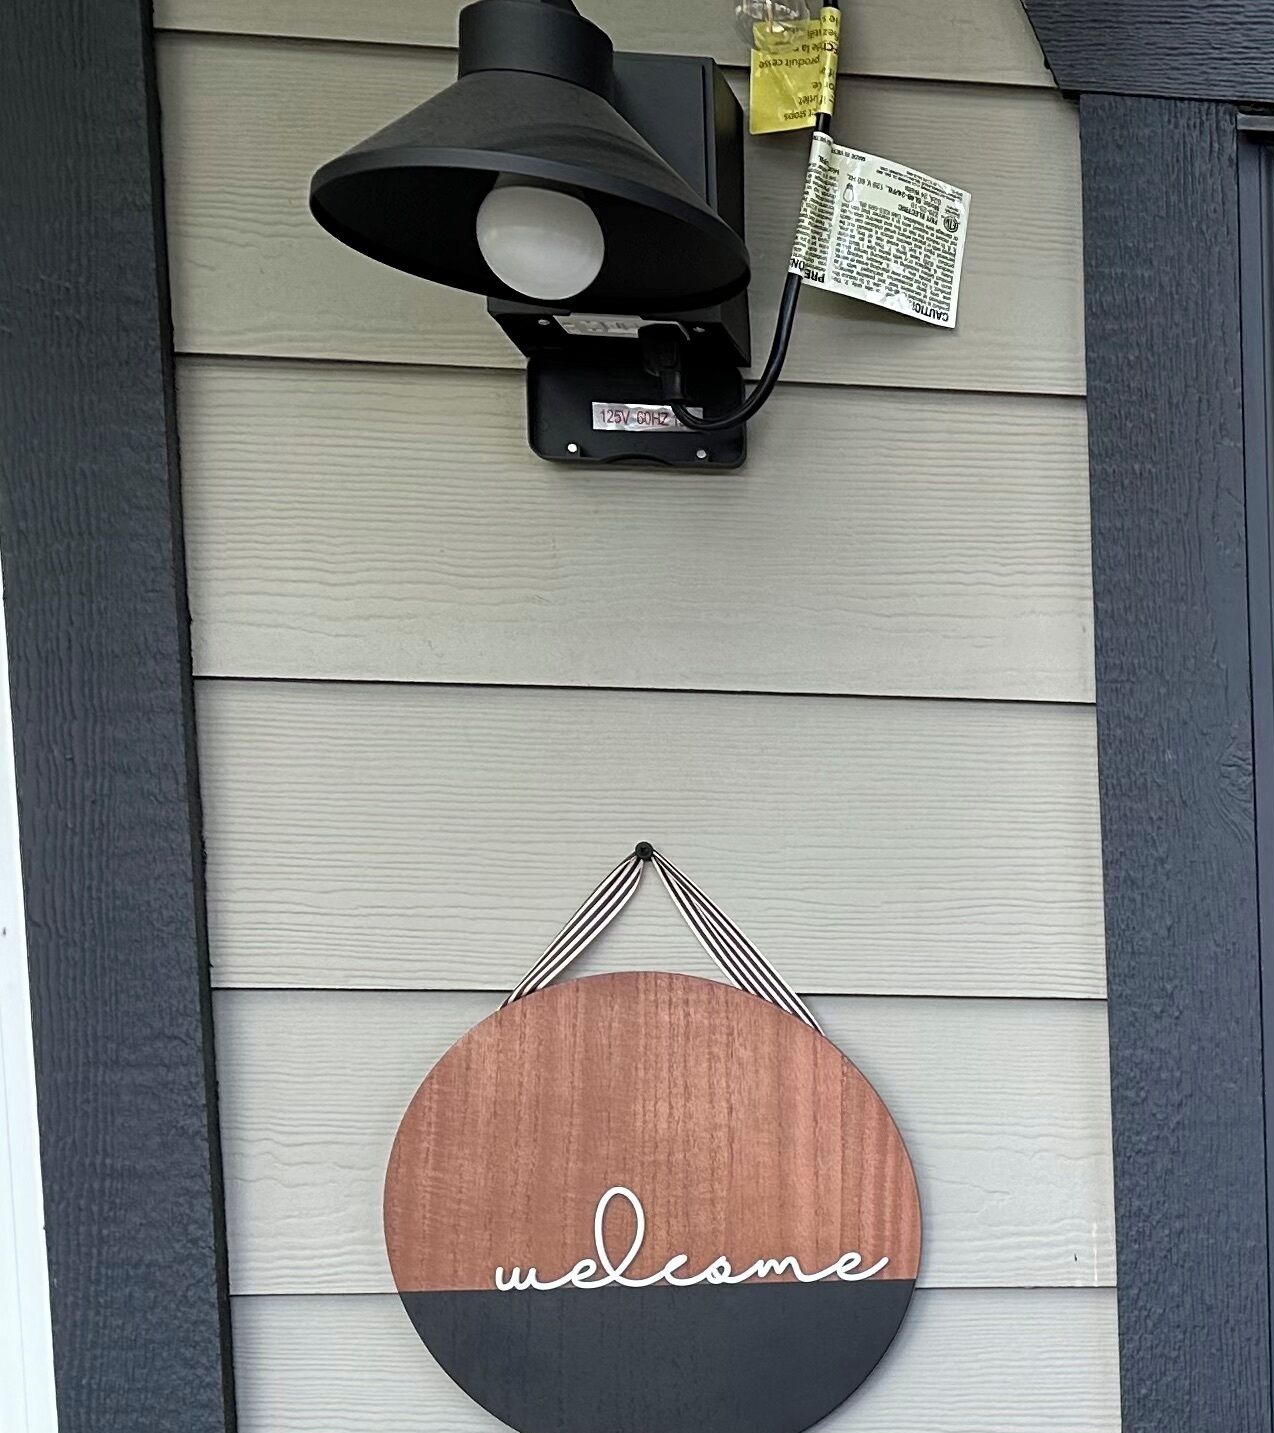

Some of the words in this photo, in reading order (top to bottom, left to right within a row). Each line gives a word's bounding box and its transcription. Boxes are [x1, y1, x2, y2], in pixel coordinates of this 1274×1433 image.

[759, 59, 783, 69] cesse
[786, 54, 821, 68] produit
[600, 409, 631, 426] 125V
[636, 410, 671, 426] 60HZ
[494, 1185, 890, 1291] welcome
